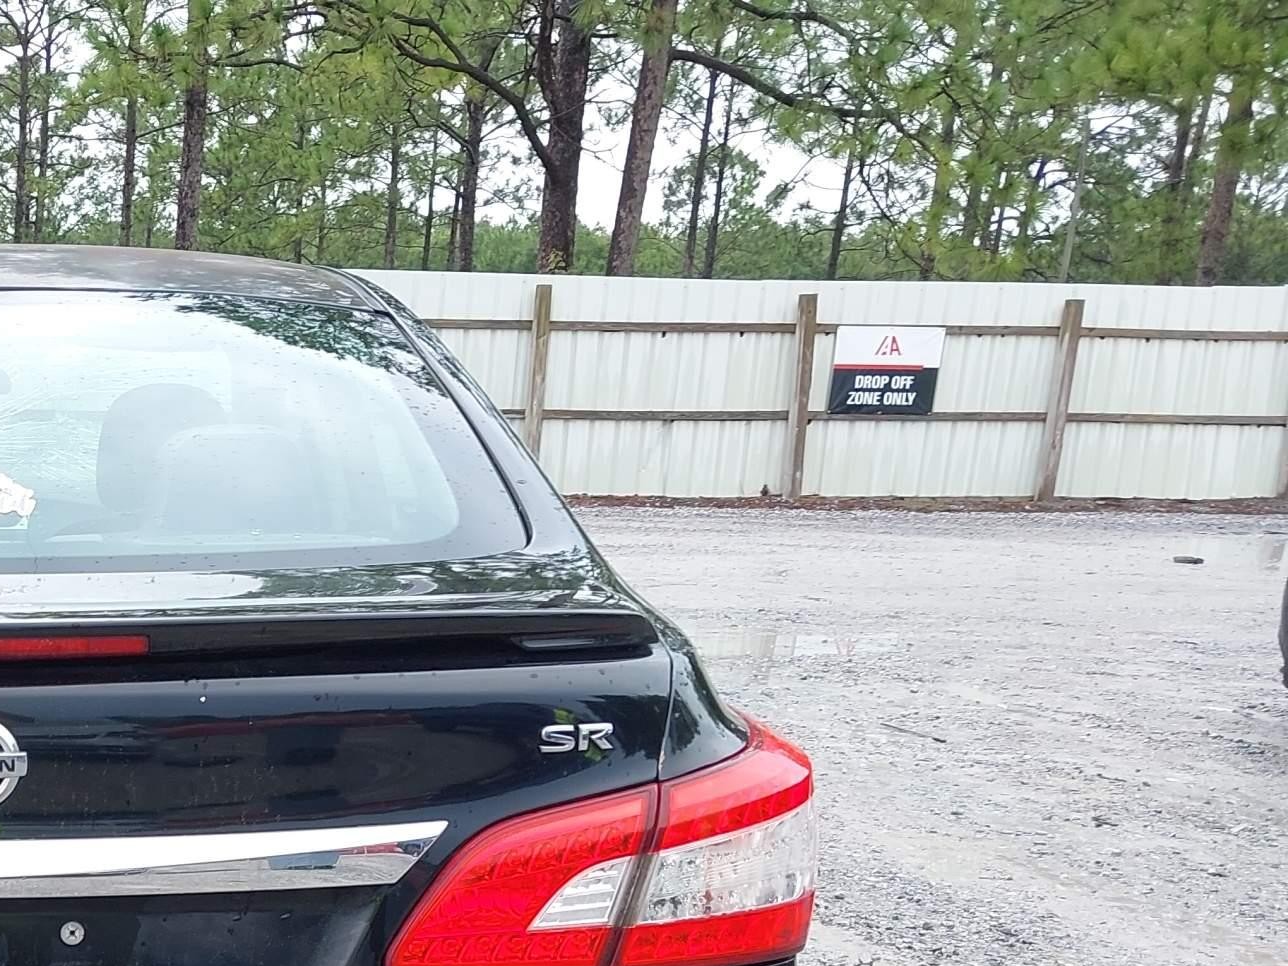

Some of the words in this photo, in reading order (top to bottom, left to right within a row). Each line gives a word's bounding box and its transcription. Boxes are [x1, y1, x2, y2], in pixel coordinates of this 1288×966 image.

[854, 375, 889, 389] DROP
[891, 375, 915, 389] OFF
[846, 392, 881, 405] ZONE
[883, 392, 917, 405] ONLY
[538, 722, 614, 753] SR
